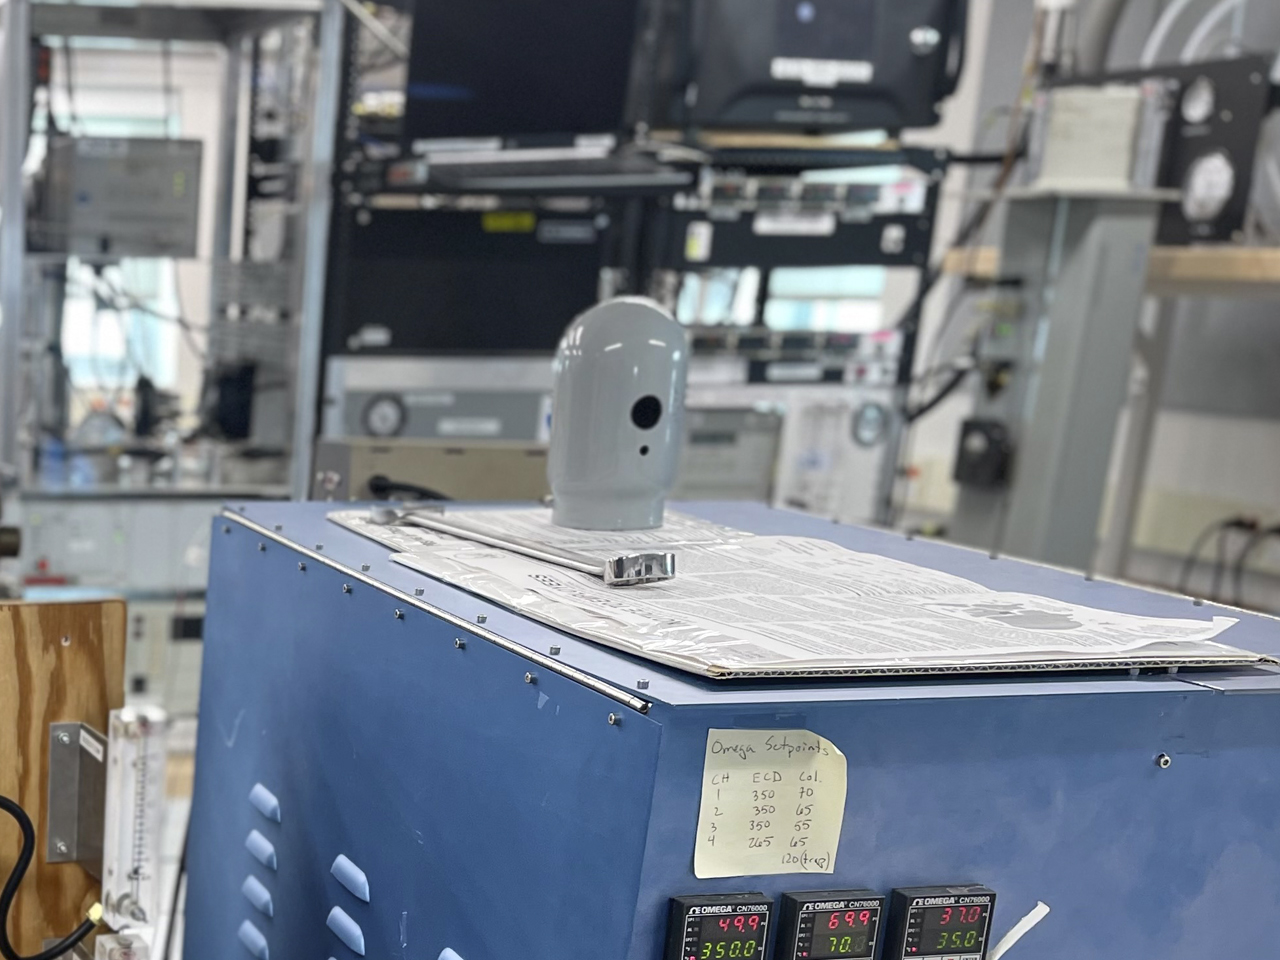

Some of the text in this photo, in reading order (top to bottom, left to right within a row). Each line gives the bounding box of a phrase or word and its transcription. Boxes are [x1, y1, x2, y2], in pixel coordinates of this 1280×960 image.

[711, 735, 829, 760] Omega Setpoints
[712, 772, 730, 785] CH
[752, 771, 782, 783] ECD
[752, 789, 775, 801] 350
[798, 787, 814, 799] 70
[714, 806, 724, 817] 2
[753, 804, 776, 816] 350
[711, 819, 812, 832] 3 350 55
[708, 835, 715, 846] 4
[748, 836, 774, 848] 265
[814, 901, 845, 909] OMEGA
[924, 897, 955, 905] OMEGA
[701, 904, 768, 914] OMEGA CN76000
[940, 906, 981, 925] 37.0
[700, 940, 756, 960] 350.0
